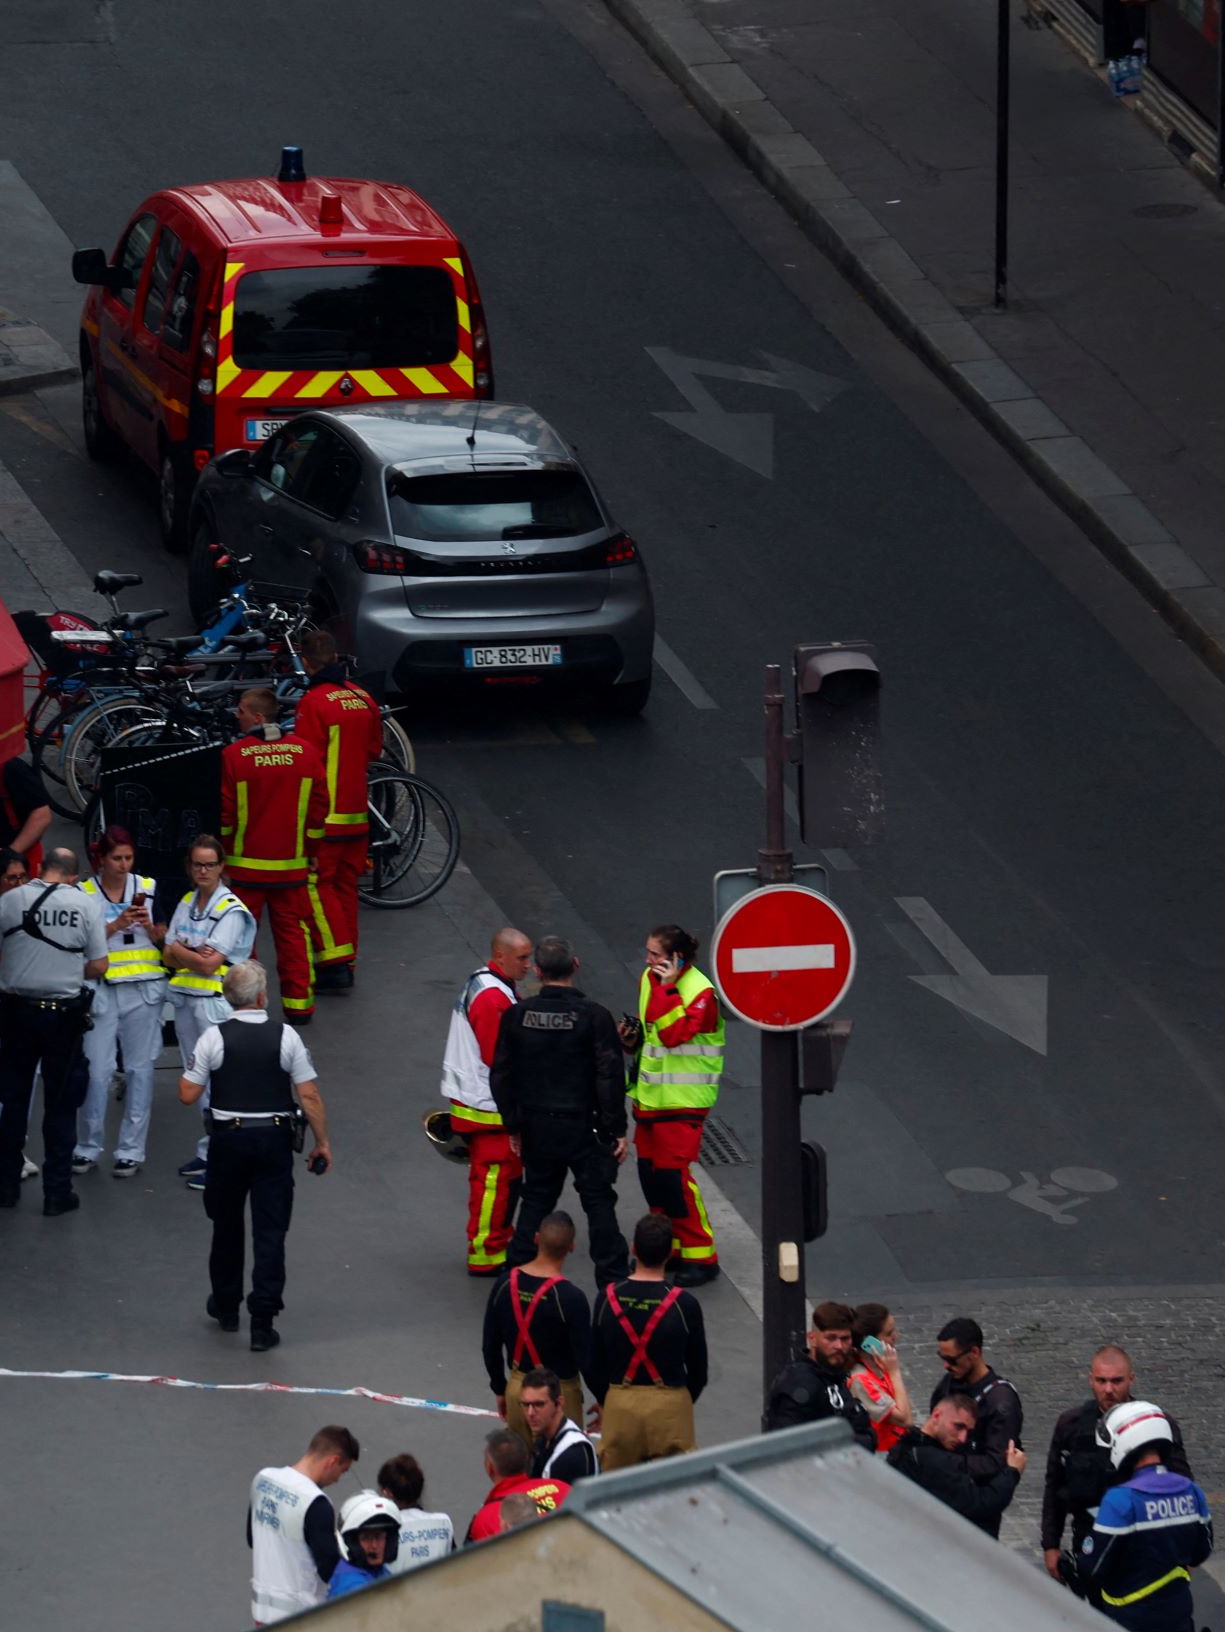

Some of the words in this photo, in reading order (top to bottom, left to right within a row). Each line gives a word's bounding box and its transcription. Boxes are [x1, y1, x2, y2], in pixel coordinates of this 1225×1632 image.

[475, 647, 551, 665] GC-832-HV
[255, 754, 293, 767] PARIS
[1145, 1495, 1196, 1520] POLICE
